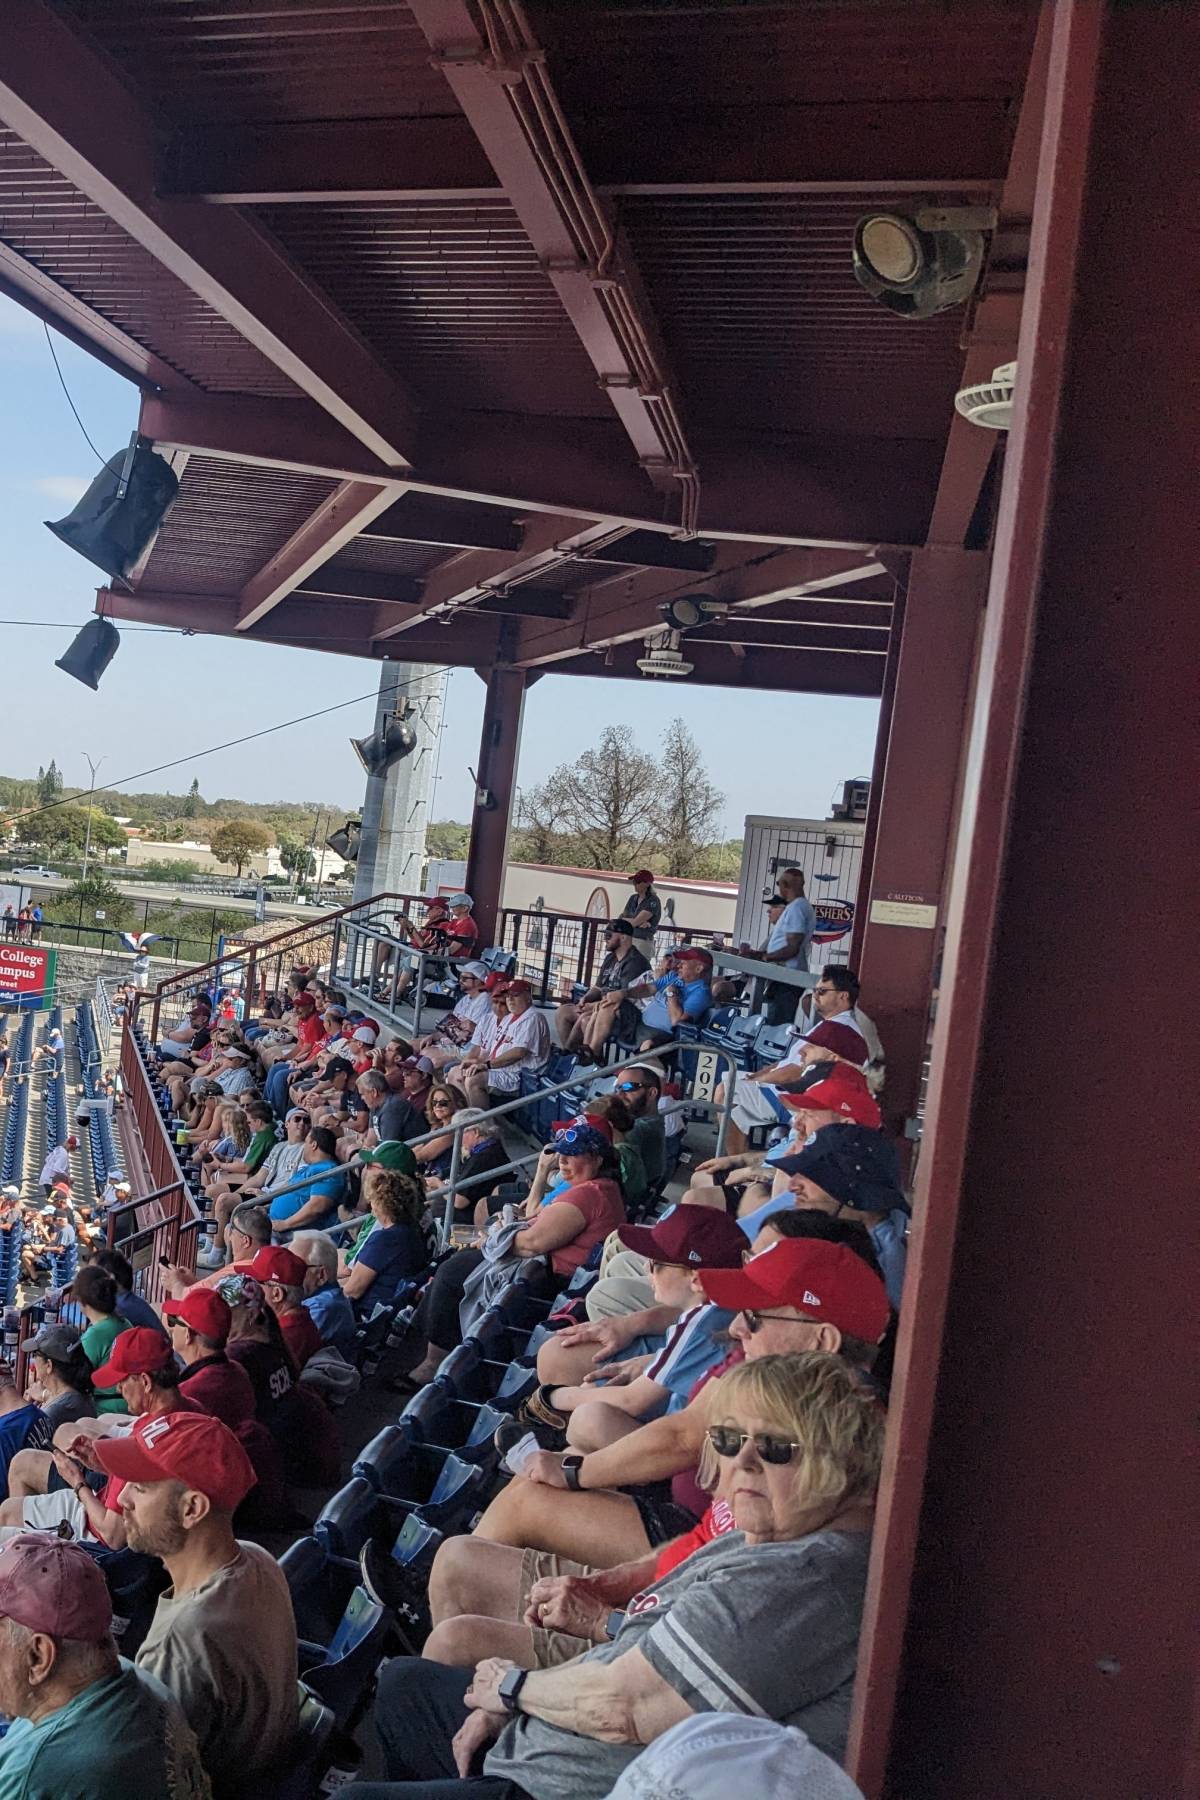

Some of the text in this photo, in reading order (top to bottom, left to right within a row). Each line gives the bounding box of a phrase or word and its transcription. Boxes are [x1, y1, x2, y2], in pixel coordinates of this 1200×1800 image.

[887, 891, 924, 903] CAUTION
[816, 904, 851, 921] ESHERS
[0, 949, 44, 967] College
